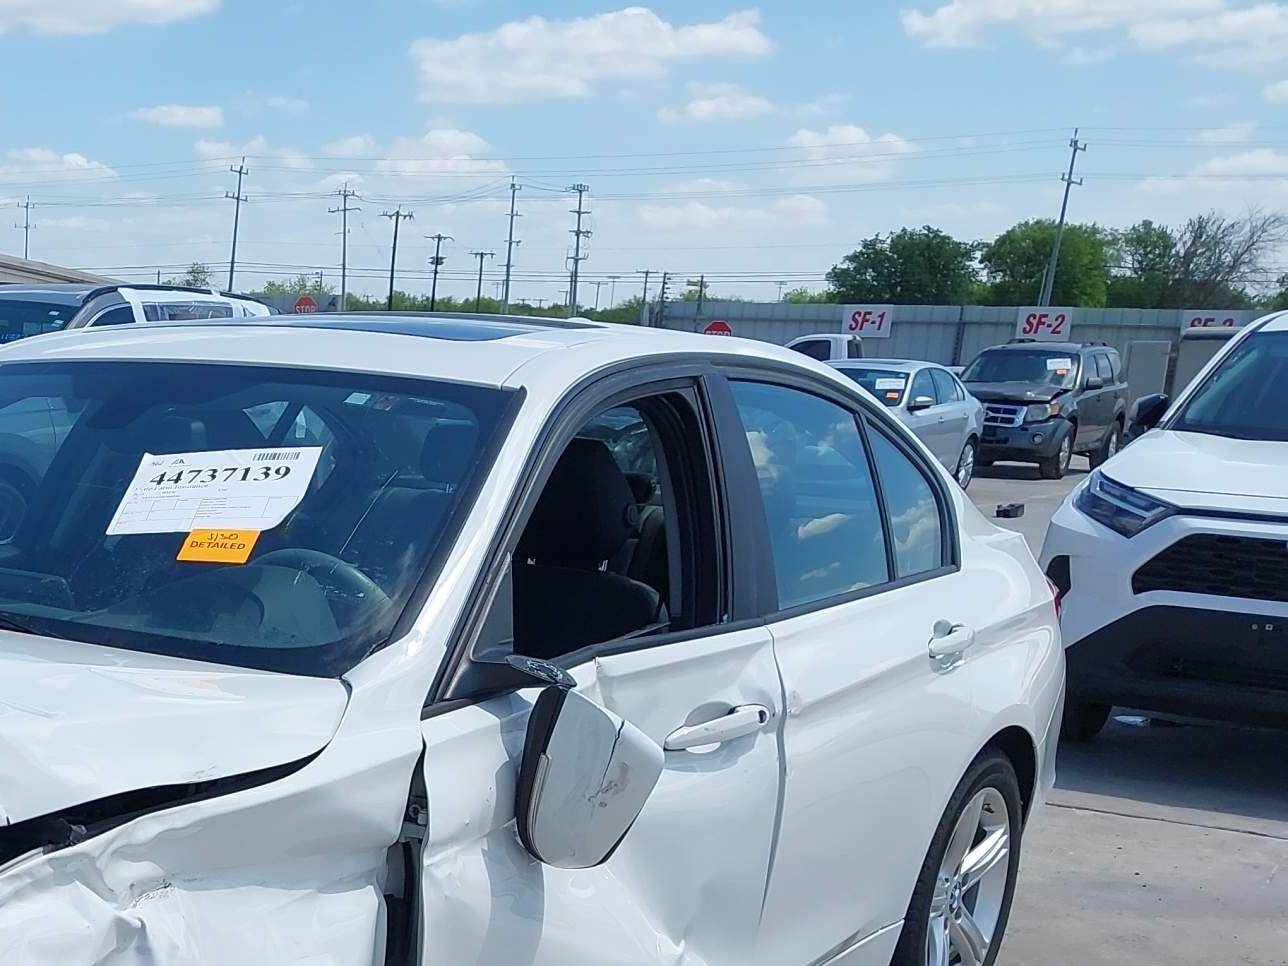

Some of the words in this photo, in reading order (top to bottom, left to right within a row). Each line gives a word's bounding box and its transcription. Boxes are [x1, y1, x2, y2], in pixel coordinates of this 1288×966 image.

[848, 310, 886, 331] SF-1
[1022, 313, 1066, 335] SF-2
[149, 465, 291, 486] 44737139
[190, 540, 246, 550] DETAILED
